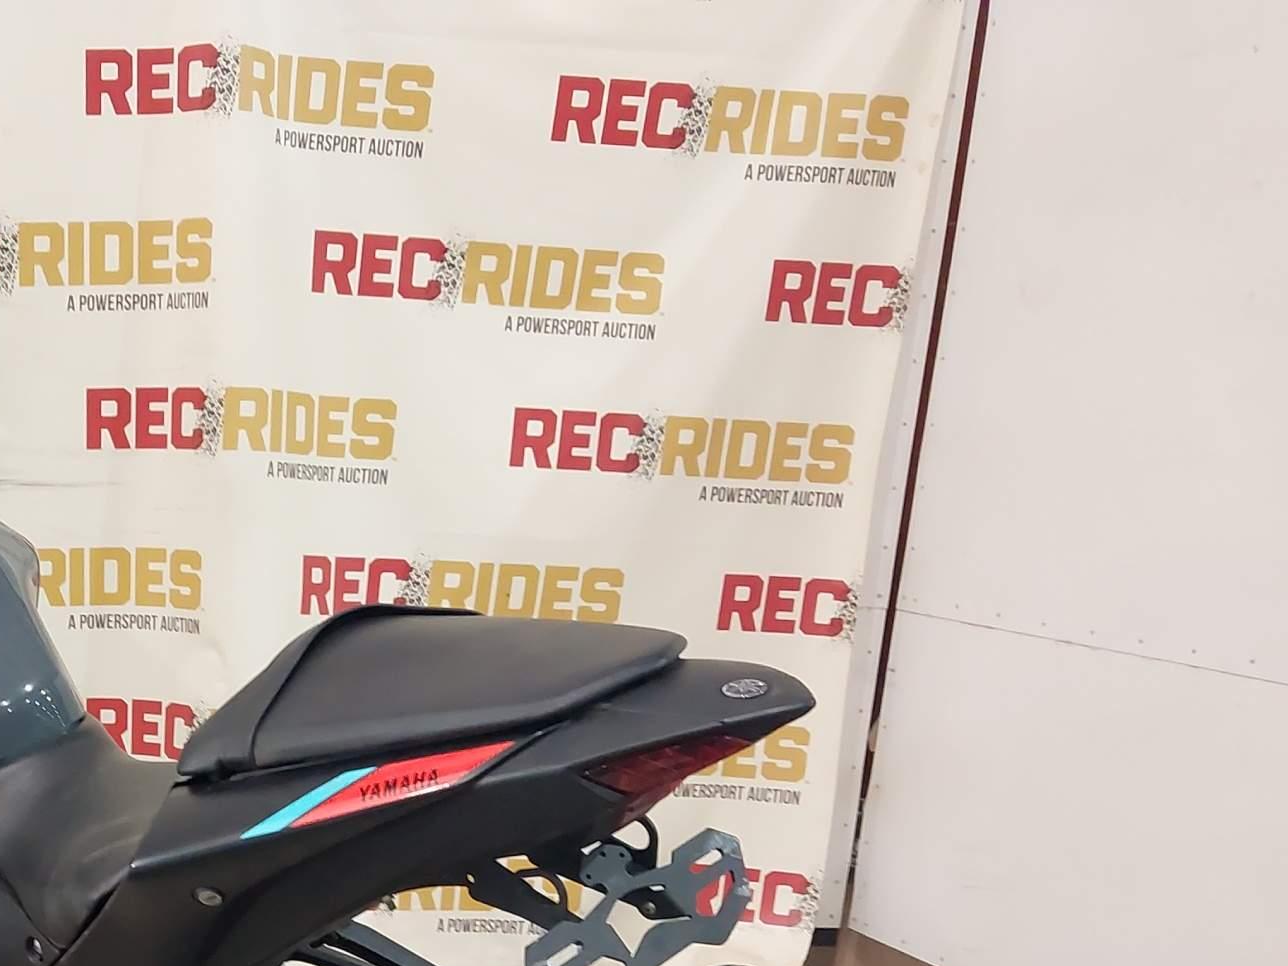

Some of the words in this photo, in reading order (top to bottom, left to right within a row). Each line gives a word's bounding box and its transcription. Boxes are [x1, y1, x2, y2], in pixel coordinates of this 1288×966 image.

[85, 44, 219, 116] REC
[236, 45, 435, 132] RIDES
[274, 127, 283, 146] A
[283, 129, 366, 155] POWERSPORT
[367, 137, 425, 159] AUCTION
[550, 75, 696, 150] REC
[703, 85, 910, 162] RIDES
[743, 163, 753, 181] A
[756, 163, 846, 186] POWERSPORT
[846, 167, 897, 189] AUCTION
[17, 217, 213, 288] RIDES
[310, 230, 448, 301] REC
[459, 240, 665, 316] RIDES
[66, 294, 76, 312] A
[79, 293, 164, 312] POWERSPORT
[166, 291, 209, 310] AUCTION
[764, 259, 902, 327] REC
[504, 315, 514, 333] A
[515, 315, 601, 338] POWERSPORT
[601, 320, 657, 341] AUCTION
[85, 386, 208, 450] REC
[222, 385, 398, 461] RIDES
[509, 407, 647, 474] REC
[659, 415, 855, 485] RIDES
[266, 460, 275, 478] A
[276, 461, 336, 482] POWERSPORT
[337, 466, 389, 487] AUCTION
[698, 485, 708, 502] A
[710, 486, 790, 506] POWERSPORT
[790, 489, 844, 509] AUCTION
[37, 546, 202, 611] RIDES
[300, 555, 413, 615] REC
[429, 559, 625, 625] RIDES
[67, 614, 77, 630] A
[79, 613, 159, 631] POWERSPORT
[159, 614, 201, 635] AUCTION
[716, 574, 851, 638] REC
[360, 768, 440, 802] YAMAHA
[673, 783, 745, 801] OWERSPORT
[746, 786, 801, 806] AUCTION
[447, 918, 526, 935] POWERSPORT
